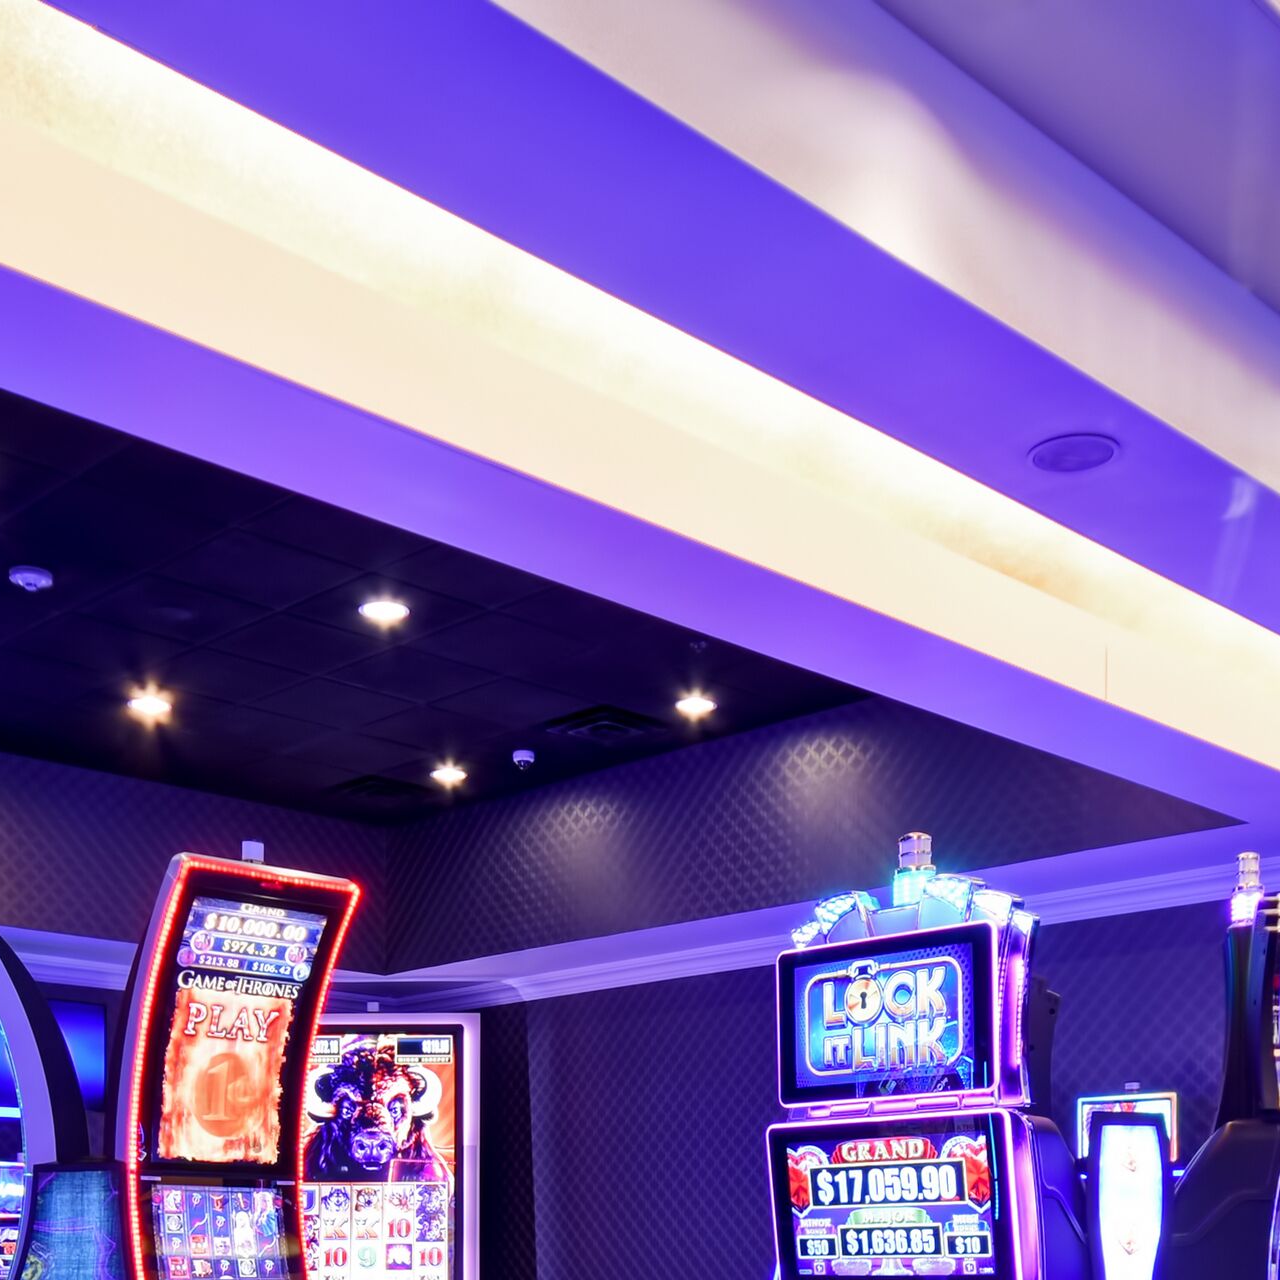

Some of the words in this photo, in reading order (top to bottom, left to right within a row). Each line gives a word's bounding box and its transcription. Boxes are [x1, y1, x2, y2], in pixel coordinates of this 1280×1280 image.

[240, 903, 286, 917] GRAND
[204, 913, 307, 942] $10,000.00
[222, 939, 278, 957] $974.34
[199, 955, 239, 968] $213.88
[177, 970, 226, 991] GAME
[235, 976, 303, 999] THRONES
[823, 962, 948, 1029] LOCK
[184, 1002, 280, 1042] PLAY
[824, 1035, 851, 1068] IT
[852, 1016, 950, 1072] LINK
[841, 1140, 925, 1162] GRAND
[816, 1164, 957, 1205] $17,059.90
[388, 1218, 411, 1238] 10
[807, 1239, 829, 1255] $50
[955, 1236, 981, 1254] $10
[846, 1229, 935, 1255] $1,636.85
[324, 1247, 347, 1267] 10
[358, 1246, 376, 1268] 9
[419, 1247, 443, 1267] 10
